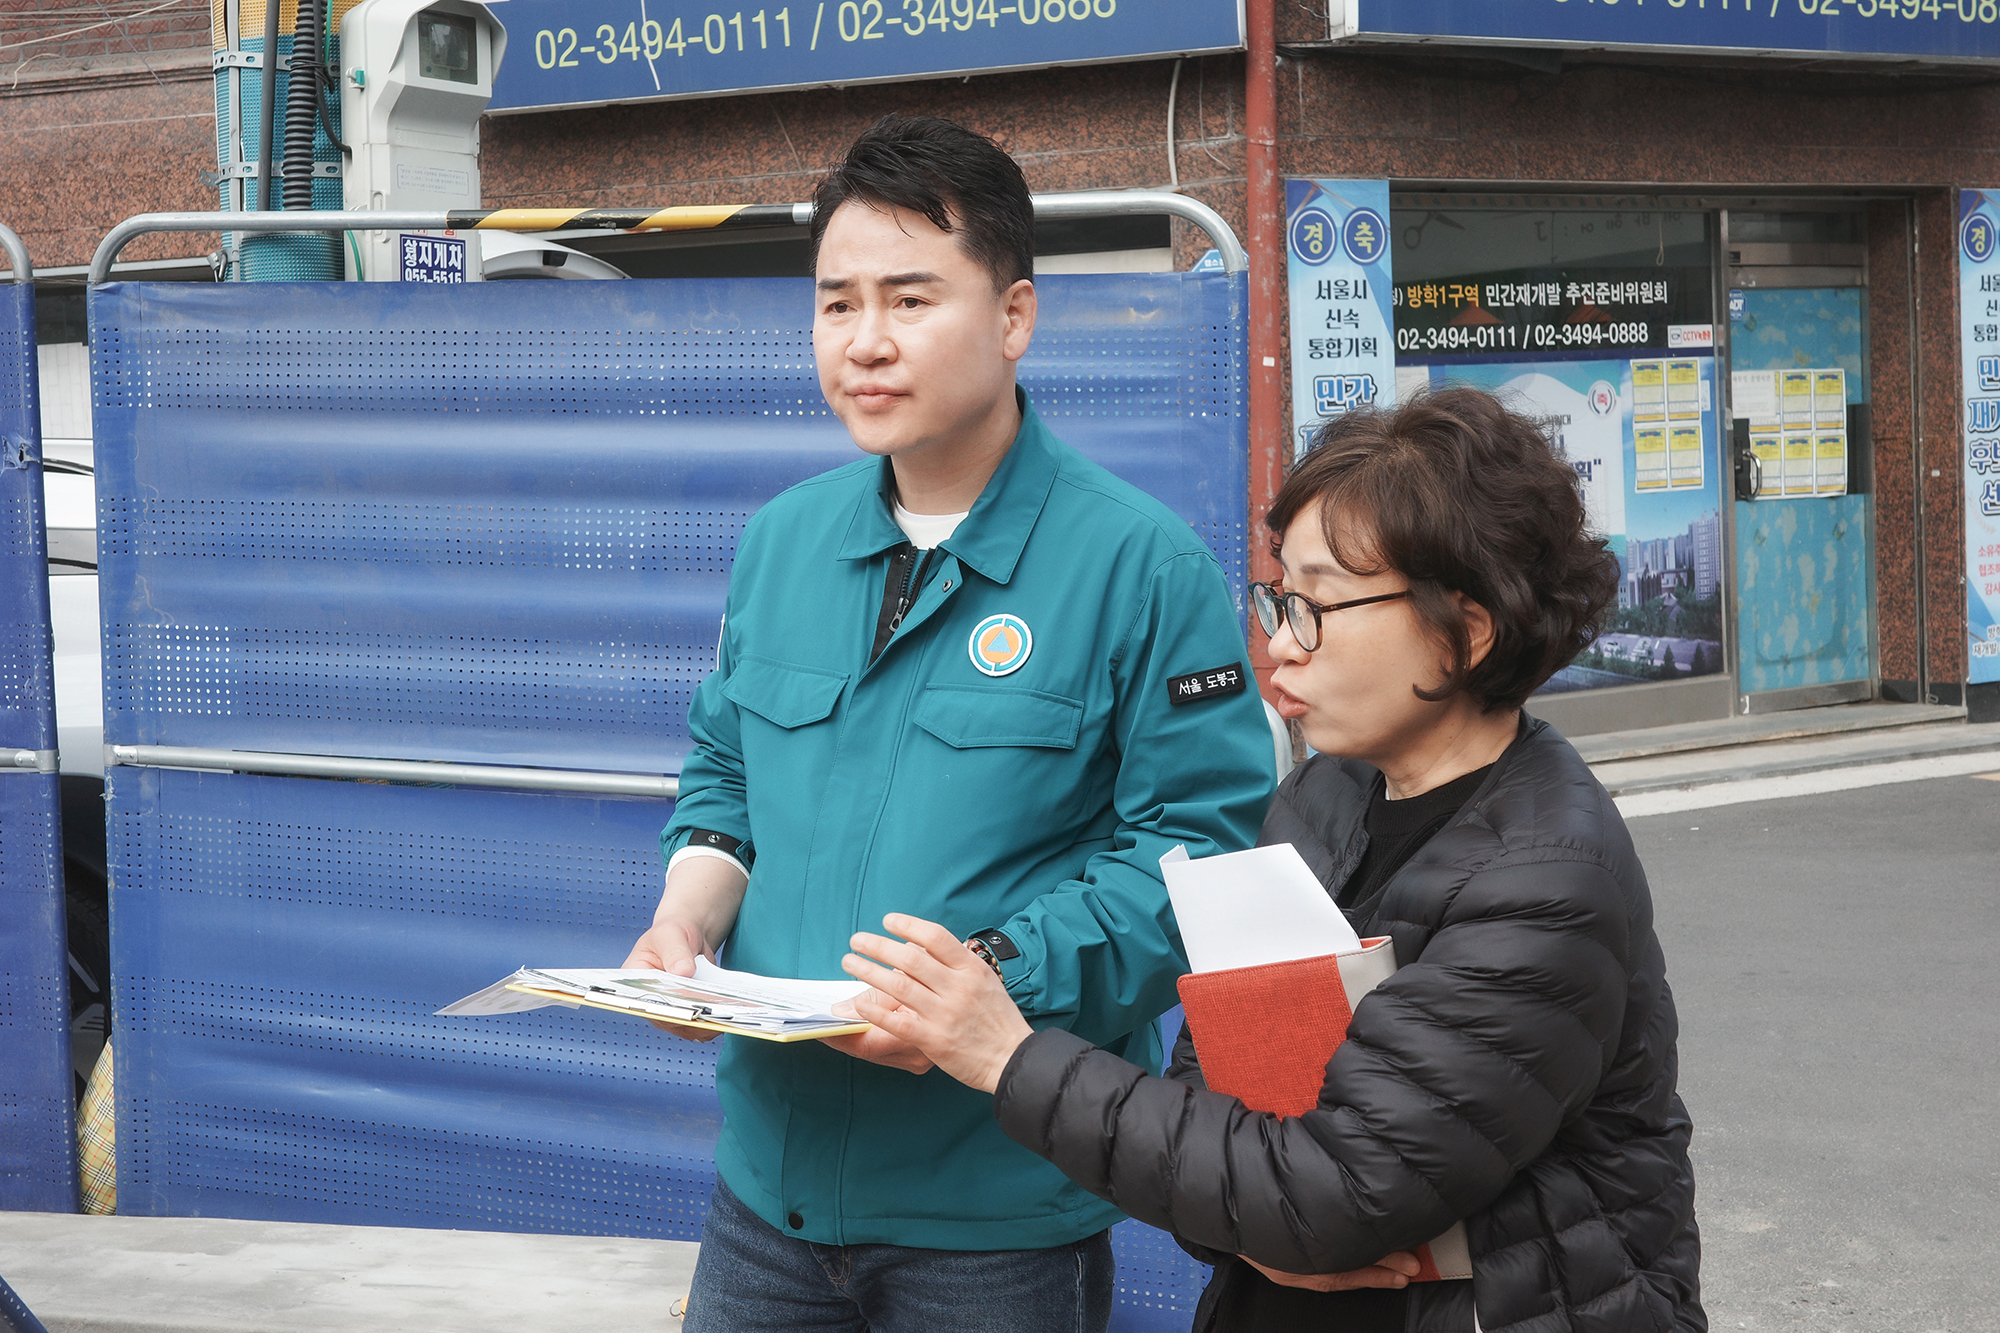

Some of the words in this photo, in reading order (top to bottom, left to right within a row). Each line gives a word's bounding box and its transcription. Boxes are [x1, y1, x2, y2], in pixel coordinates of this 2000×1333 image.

[535, 7, 791, 70] 02-3494-0111
[1315, 279, 1367, 300] 서울시
[1406, 284, 1479, 308] 방학1구역
[1485, 282, 1561, 307] 민간재개발
[1565, 280, 1668, 306] 추진준비위원회
[1326, 308, 1359, 329] 신속
[1308, 337, 1377, 359] 통합기획
[1397, 325, 1516, 350] 02-3494-0111
[1534, 321, 1649, 346] 02-3494-0888
[1314, 374, 1377, 416] 민간
[1178, 678, 1203, 695] 서울
[1206, 670, 1238, 689] 도봉구
